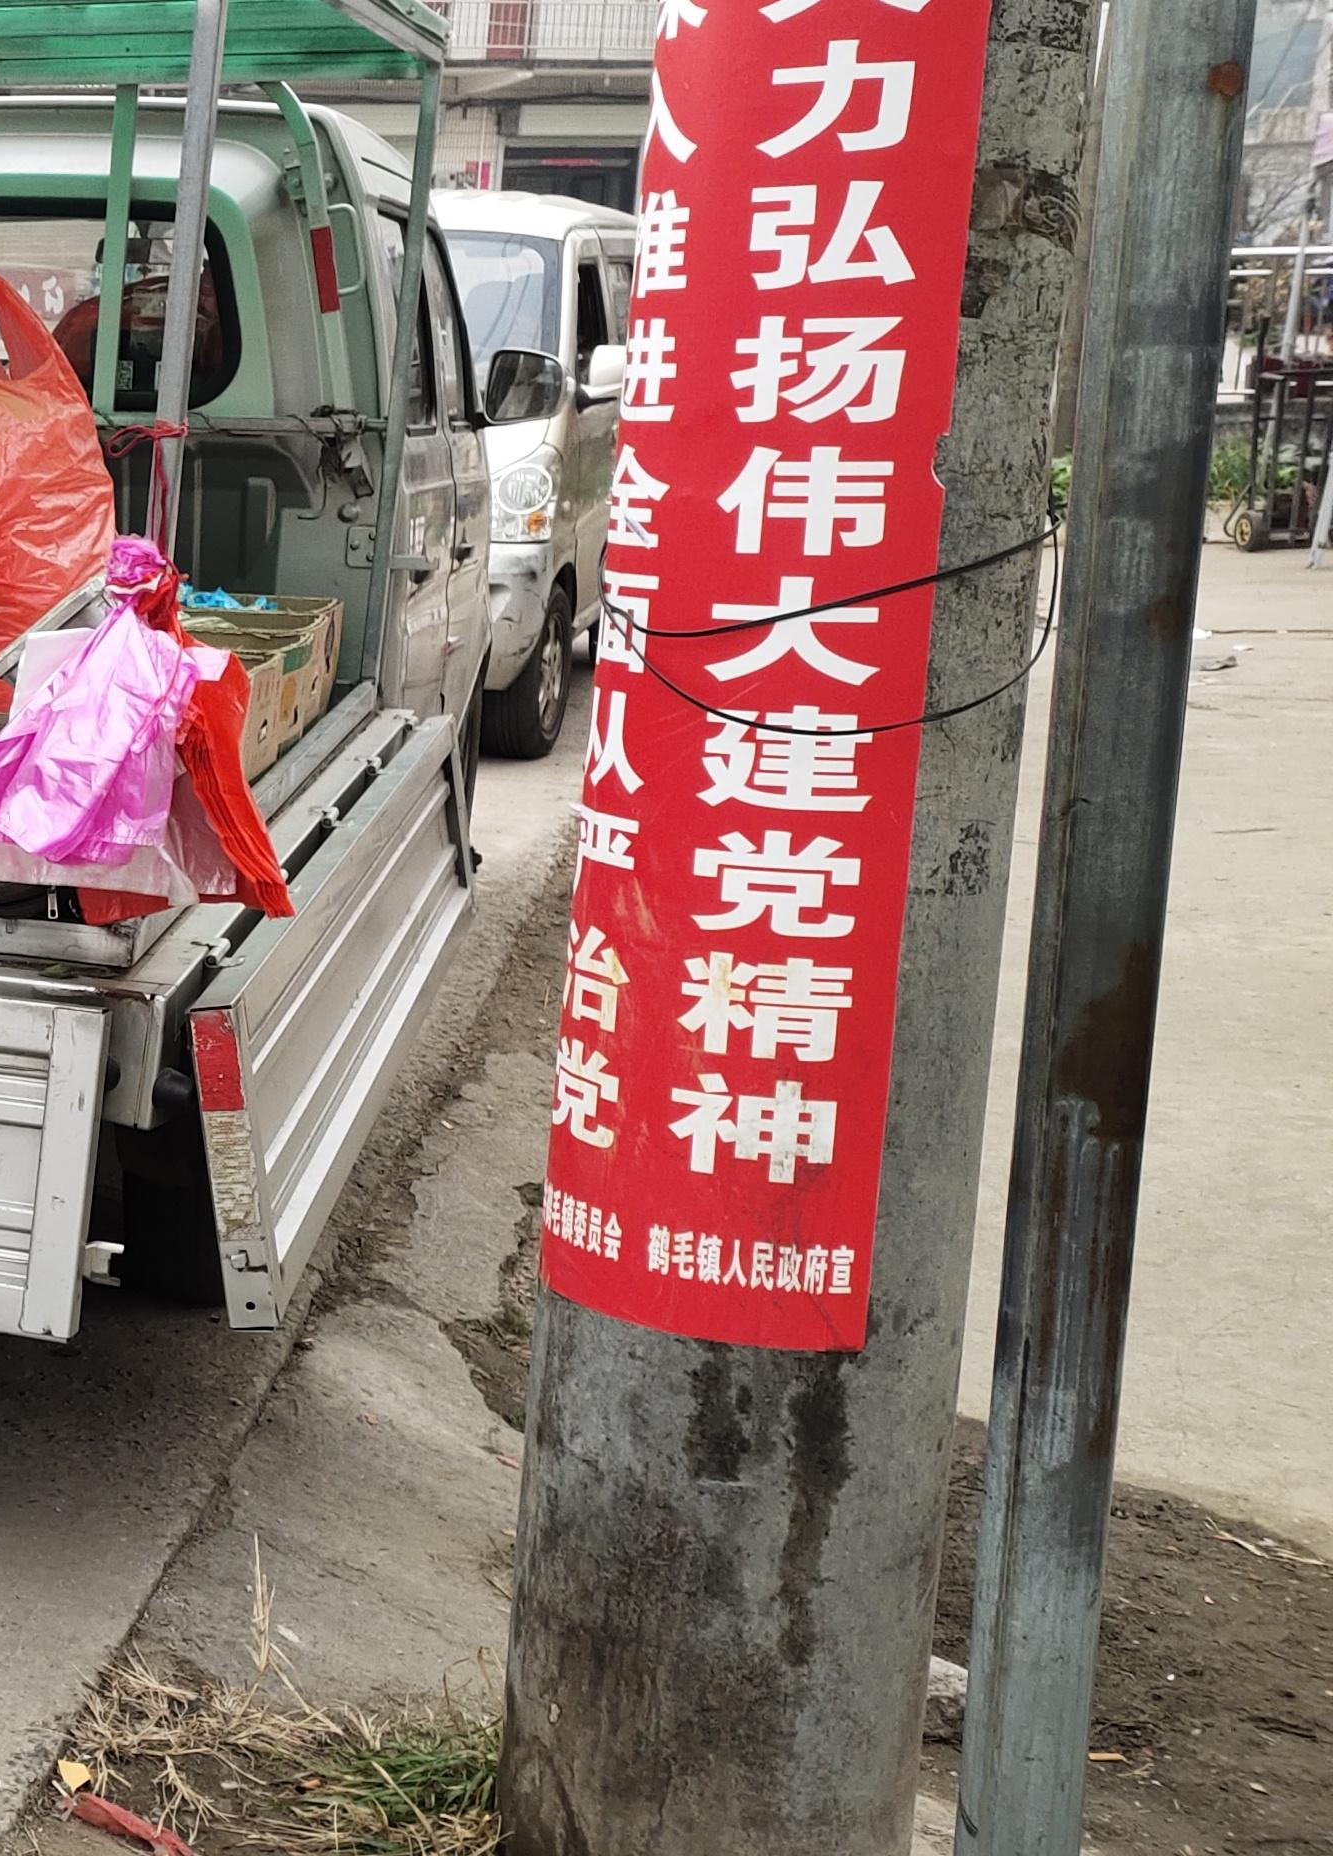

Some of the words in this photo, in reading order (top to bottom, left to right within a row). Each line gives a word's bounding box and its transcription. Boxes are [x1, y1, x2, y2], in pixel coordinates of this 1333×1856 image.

[669, 0, 931, 1184] 力弘扬伟大建党精神
[647, 1223, 855, 1295] 鹤毛镇人民政府宣
